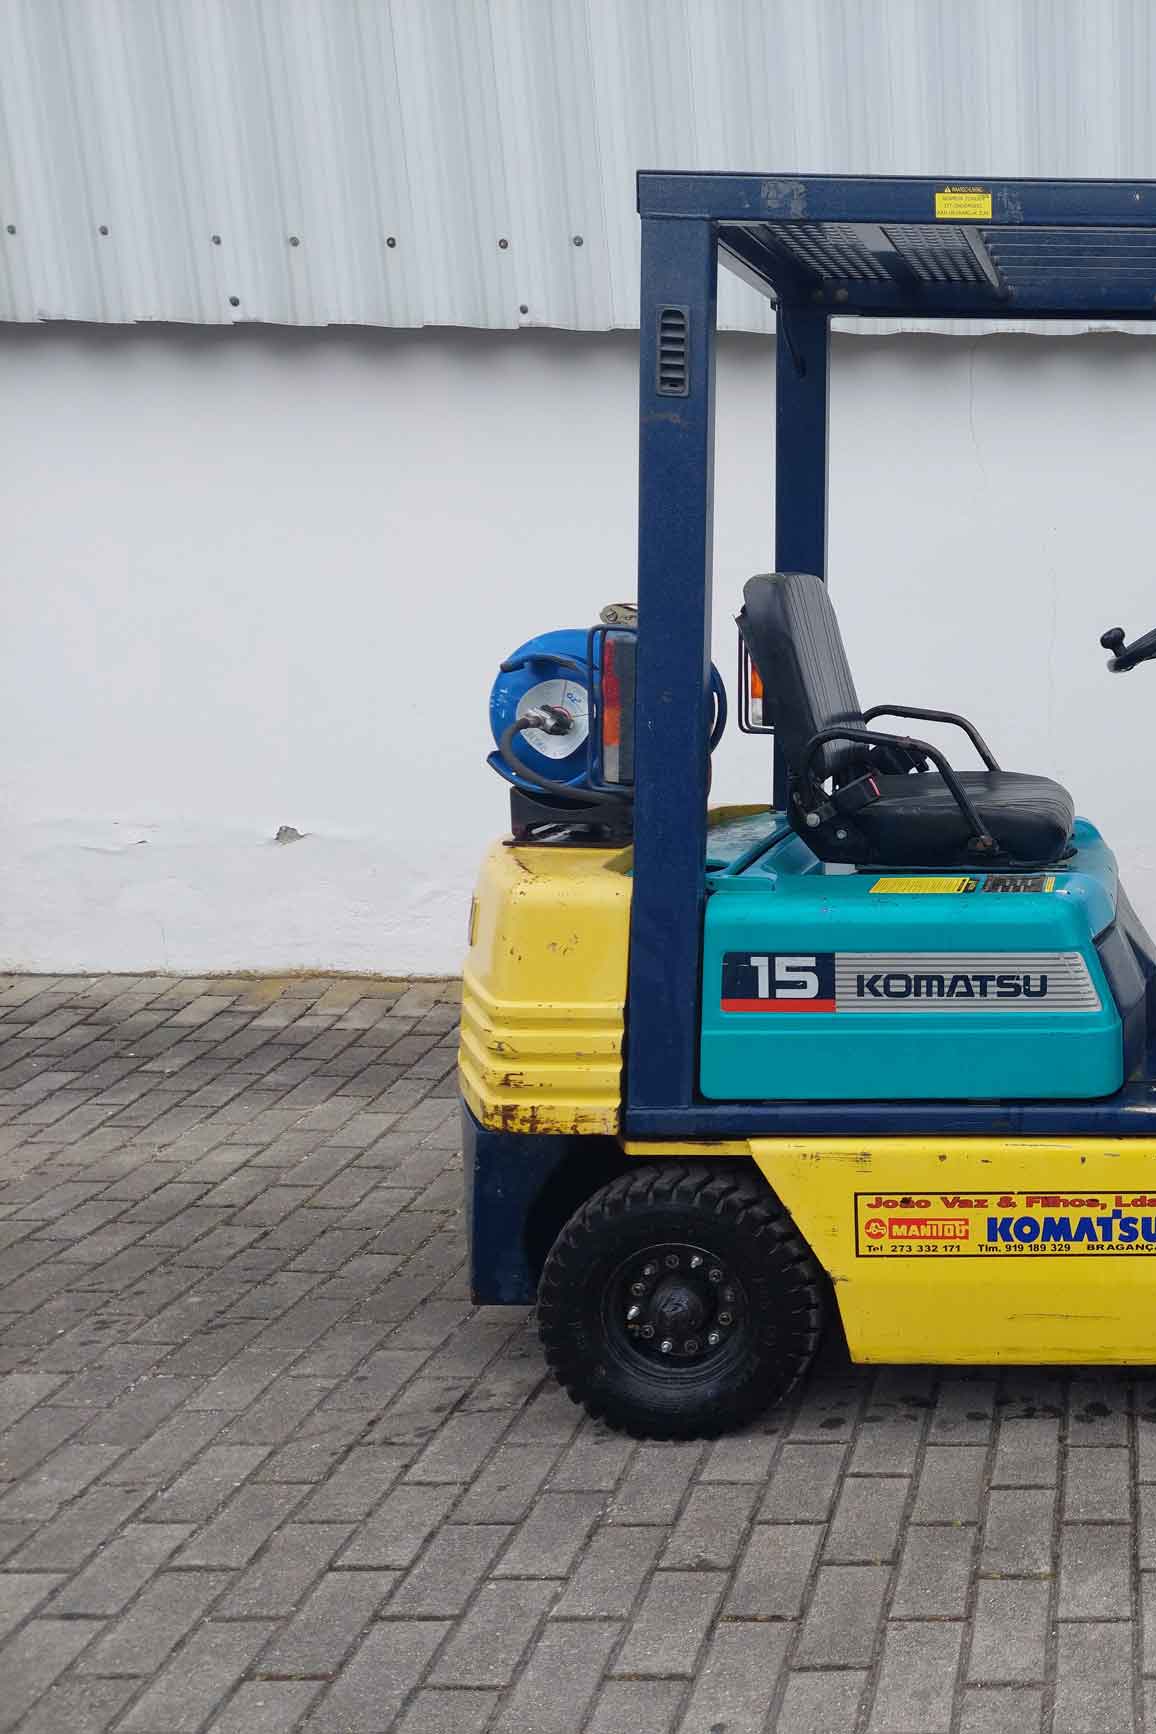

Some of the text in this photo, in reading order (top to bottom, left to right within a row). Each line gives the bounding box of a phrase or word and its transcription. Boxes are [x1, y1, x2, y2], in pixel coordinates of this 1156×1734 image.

[750, 956, 1048, 999] 15 KOMATSU
[940, 1196, 989, 1208] Vaz
[891, 1220, 968, 1237] MANITOU
[890, 1244, 912, 1253] 273
[916, 1244, 938, 1253] 332
[942, 1244, 961, 1253] 171
[1005, 1243, 1024, 1253] 919
[1028, 1243, 1047, 1253] 189
[1050, 1243, 1071, 1253] 329
